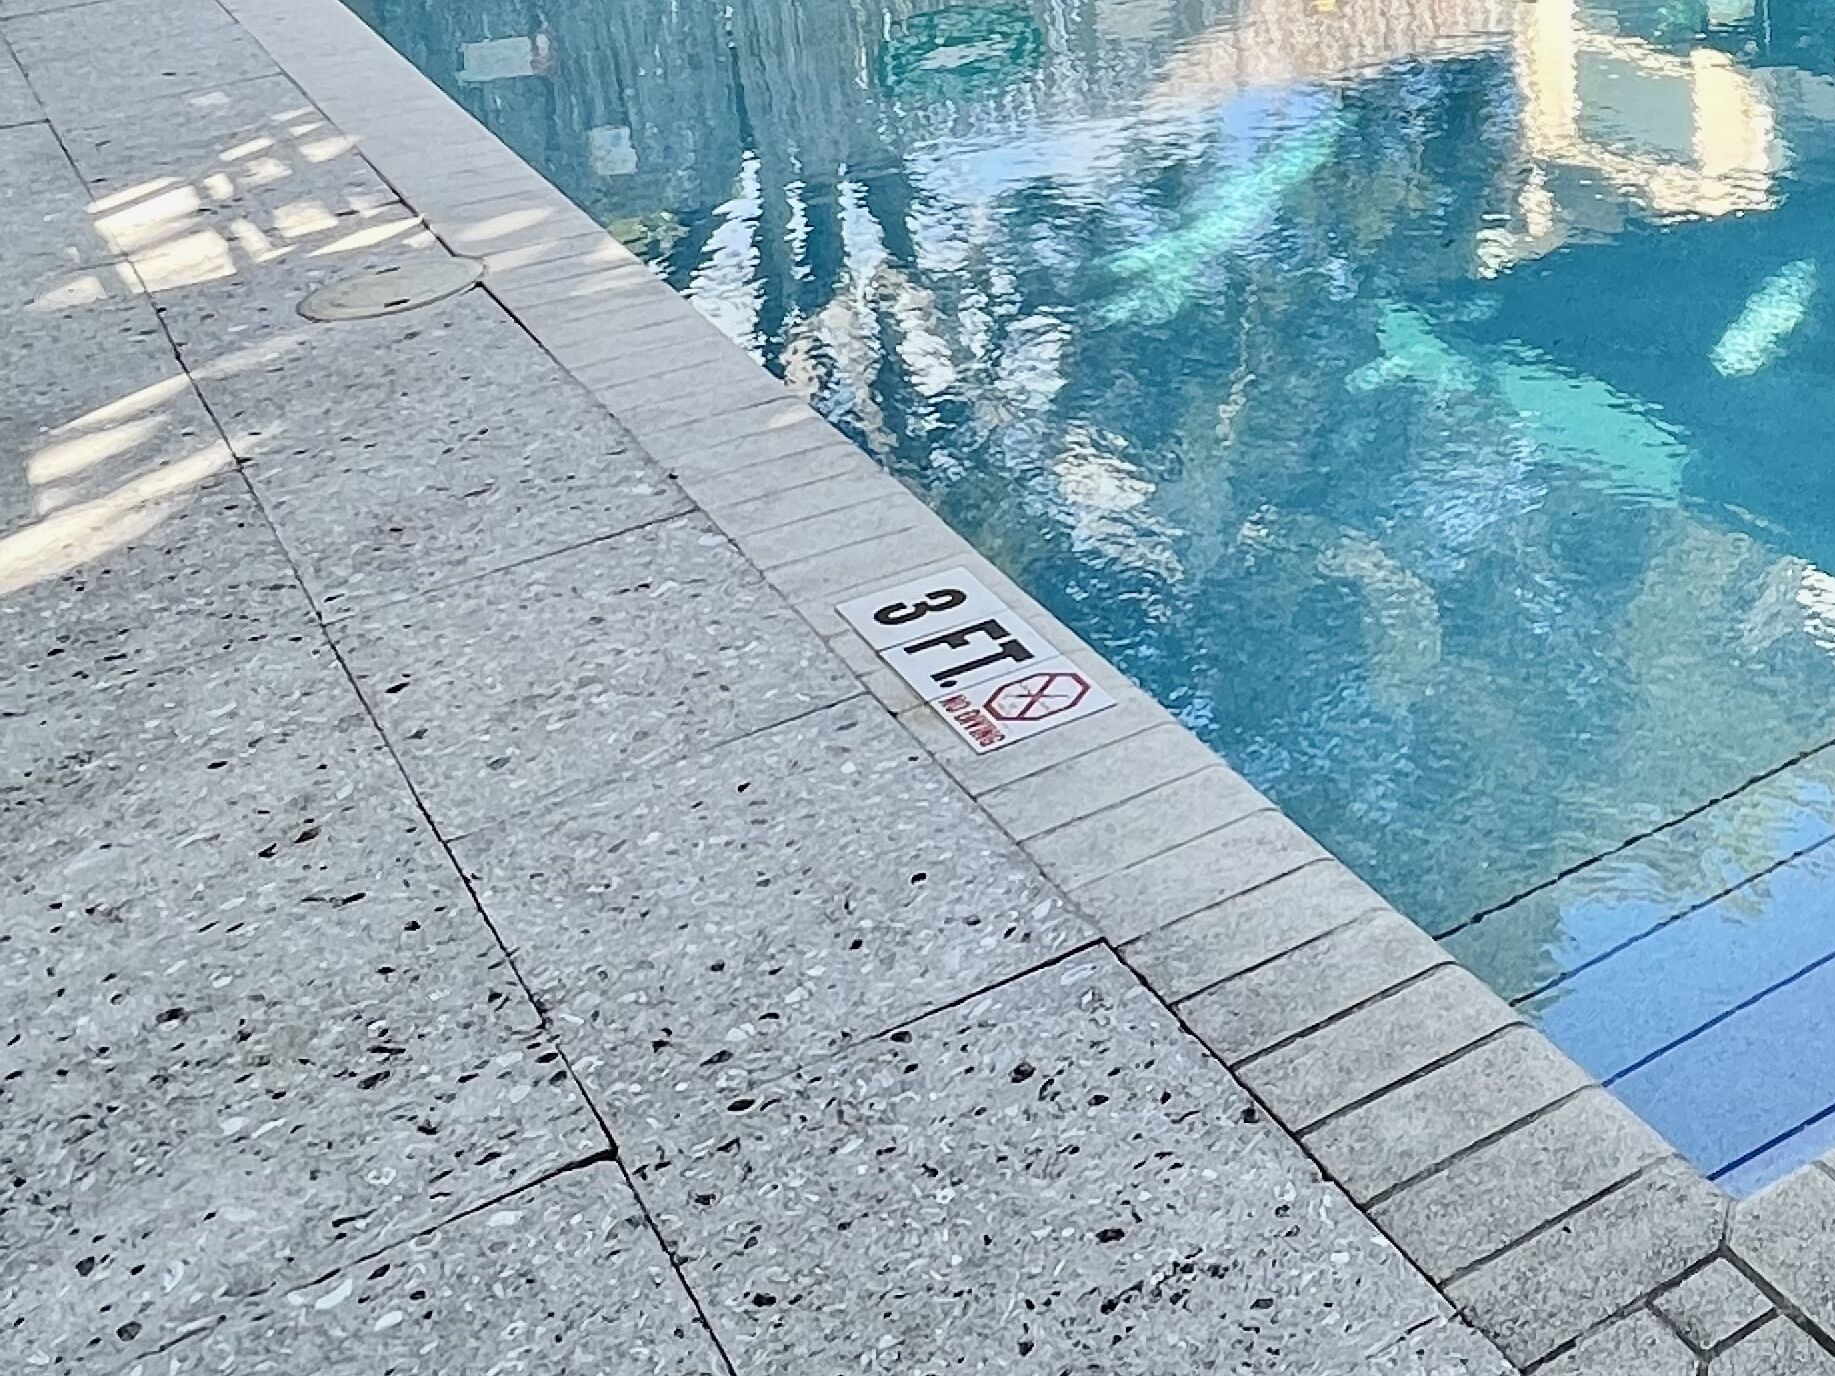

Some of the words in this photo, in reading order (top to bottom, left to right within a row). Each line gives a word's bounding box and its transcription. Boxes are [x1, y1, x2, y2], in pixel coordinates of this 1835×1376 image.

[873, 588, 968, 626] 3
[903, 618, 1035, 689] FT.
[941, 693, 972, 713] NO
[953, 708, 1006, 748] DIVING
